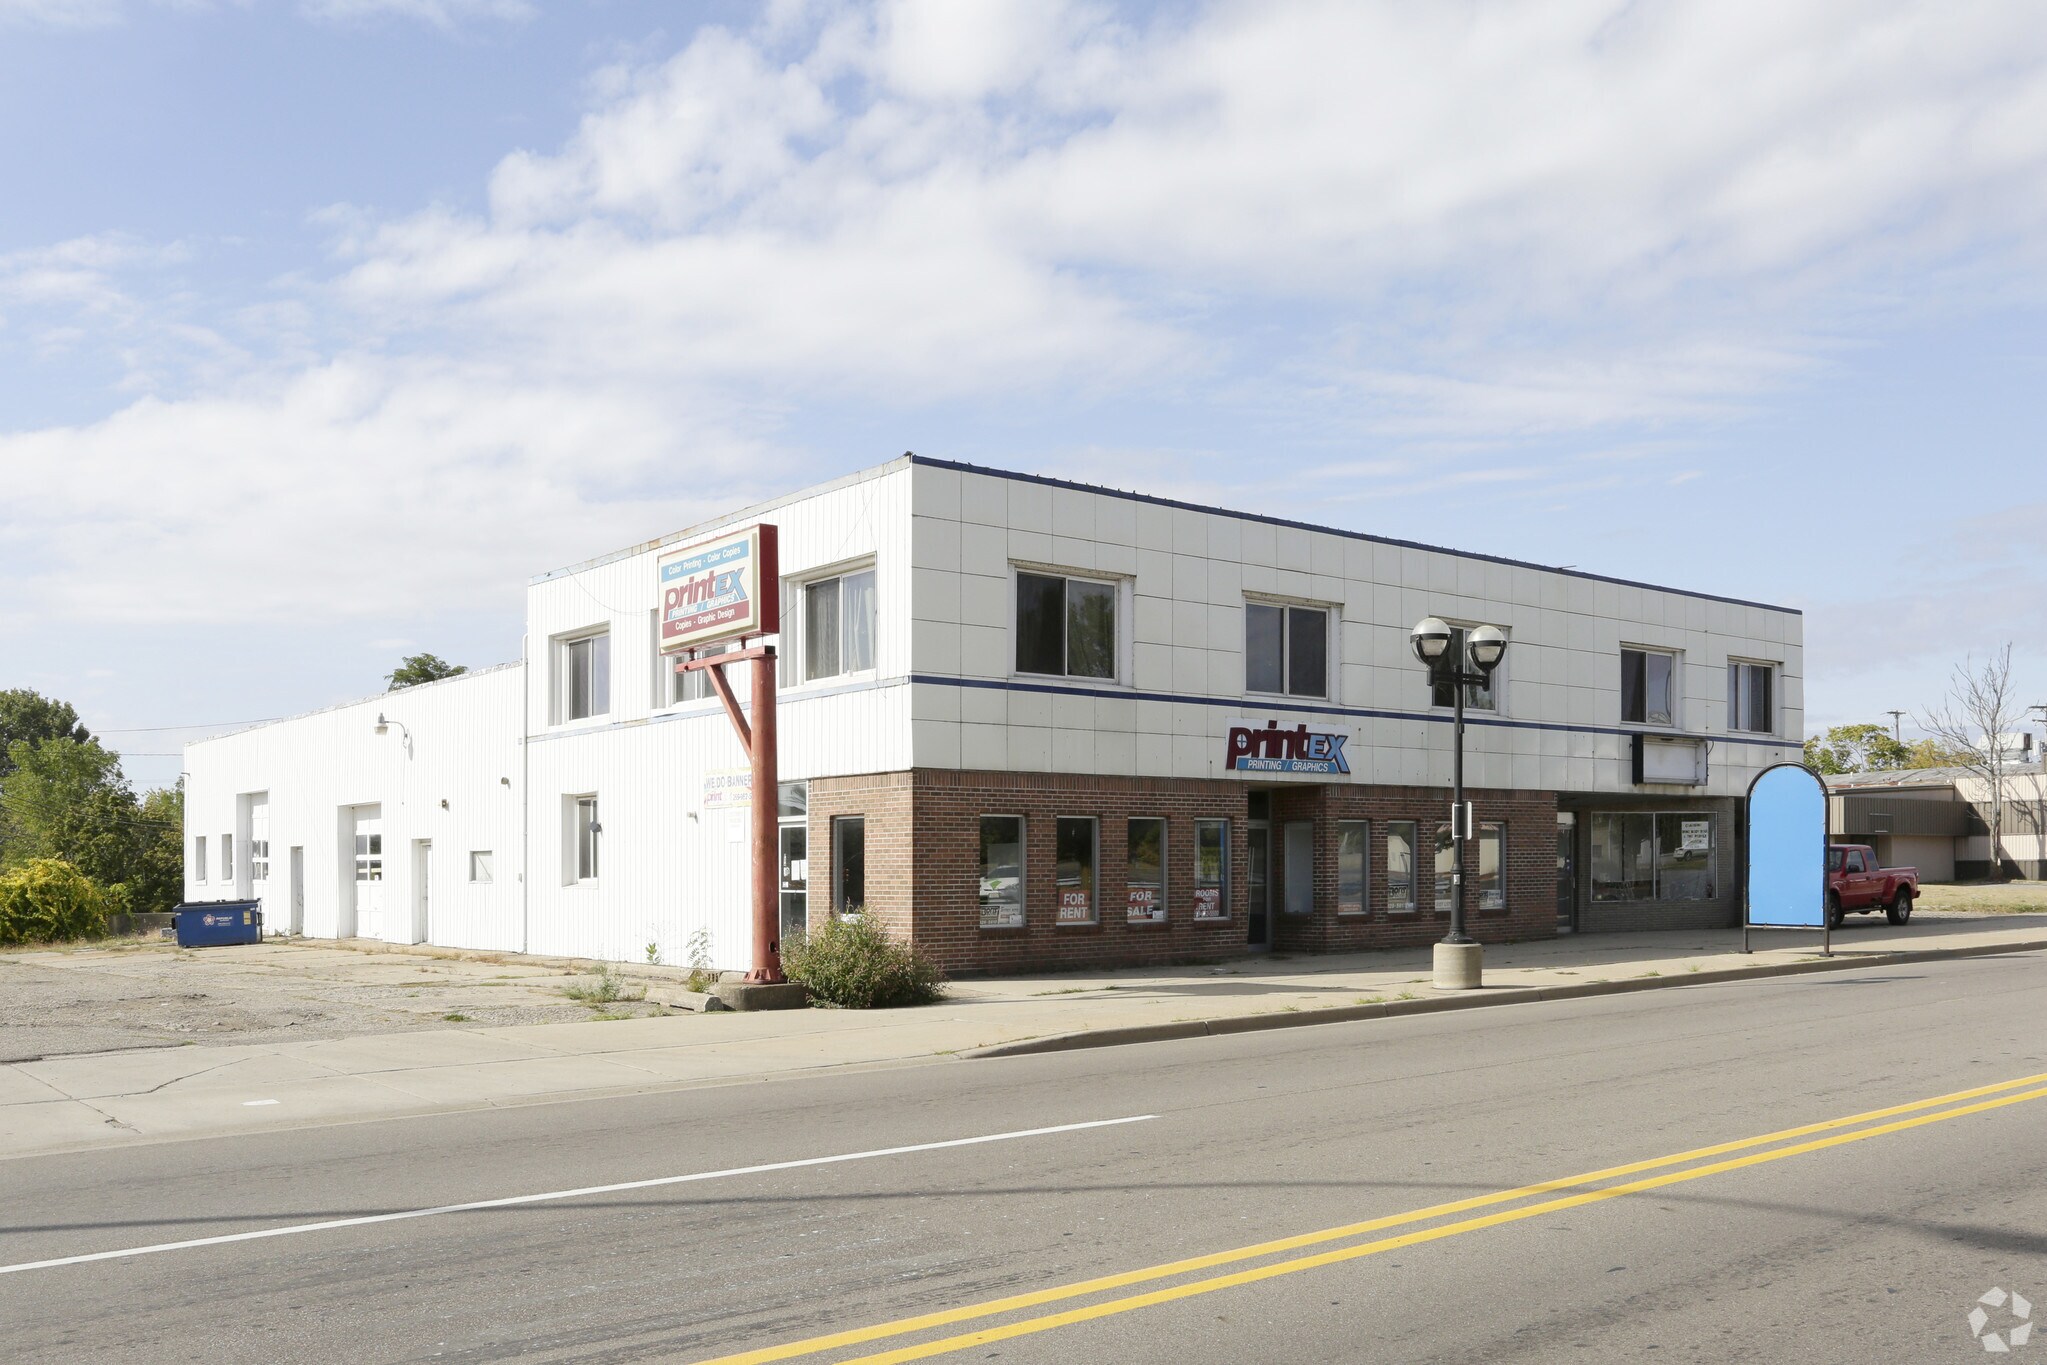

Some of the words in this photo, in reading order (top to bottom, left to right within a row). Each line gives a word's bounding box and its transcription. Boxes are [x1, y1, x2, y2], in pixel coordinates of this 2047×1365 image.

[668, 564, 682, 576] Color
[683, 558, 702, 571] Printing
[707, 553, 721, 563] Color
[722, 546, 741, 558] Copies
[672, 604, 698, 618] PRINTING
[707, 594, 735, 609] GRAPHICS
[675, 618, 692, 630] Copies
[697, 613, 716, 625] Graphic
[717, 608, 735, 620] Design
[1247, 759, 1282, 771] PRINTING
[1292, 761, 1328, 772] GRAPHICS
[716, 776, 725, 788] DO
[1063, 893, 1085, 905] FOR
[1129, 891, 1152, 902] FOR
[1195, 889, 1219, 897] ROOMS
[1127, 905, 1154, 916] SALE
[1198, 902, 1215, 910] RENT
[1060, 907, 1088, 918] RENT
